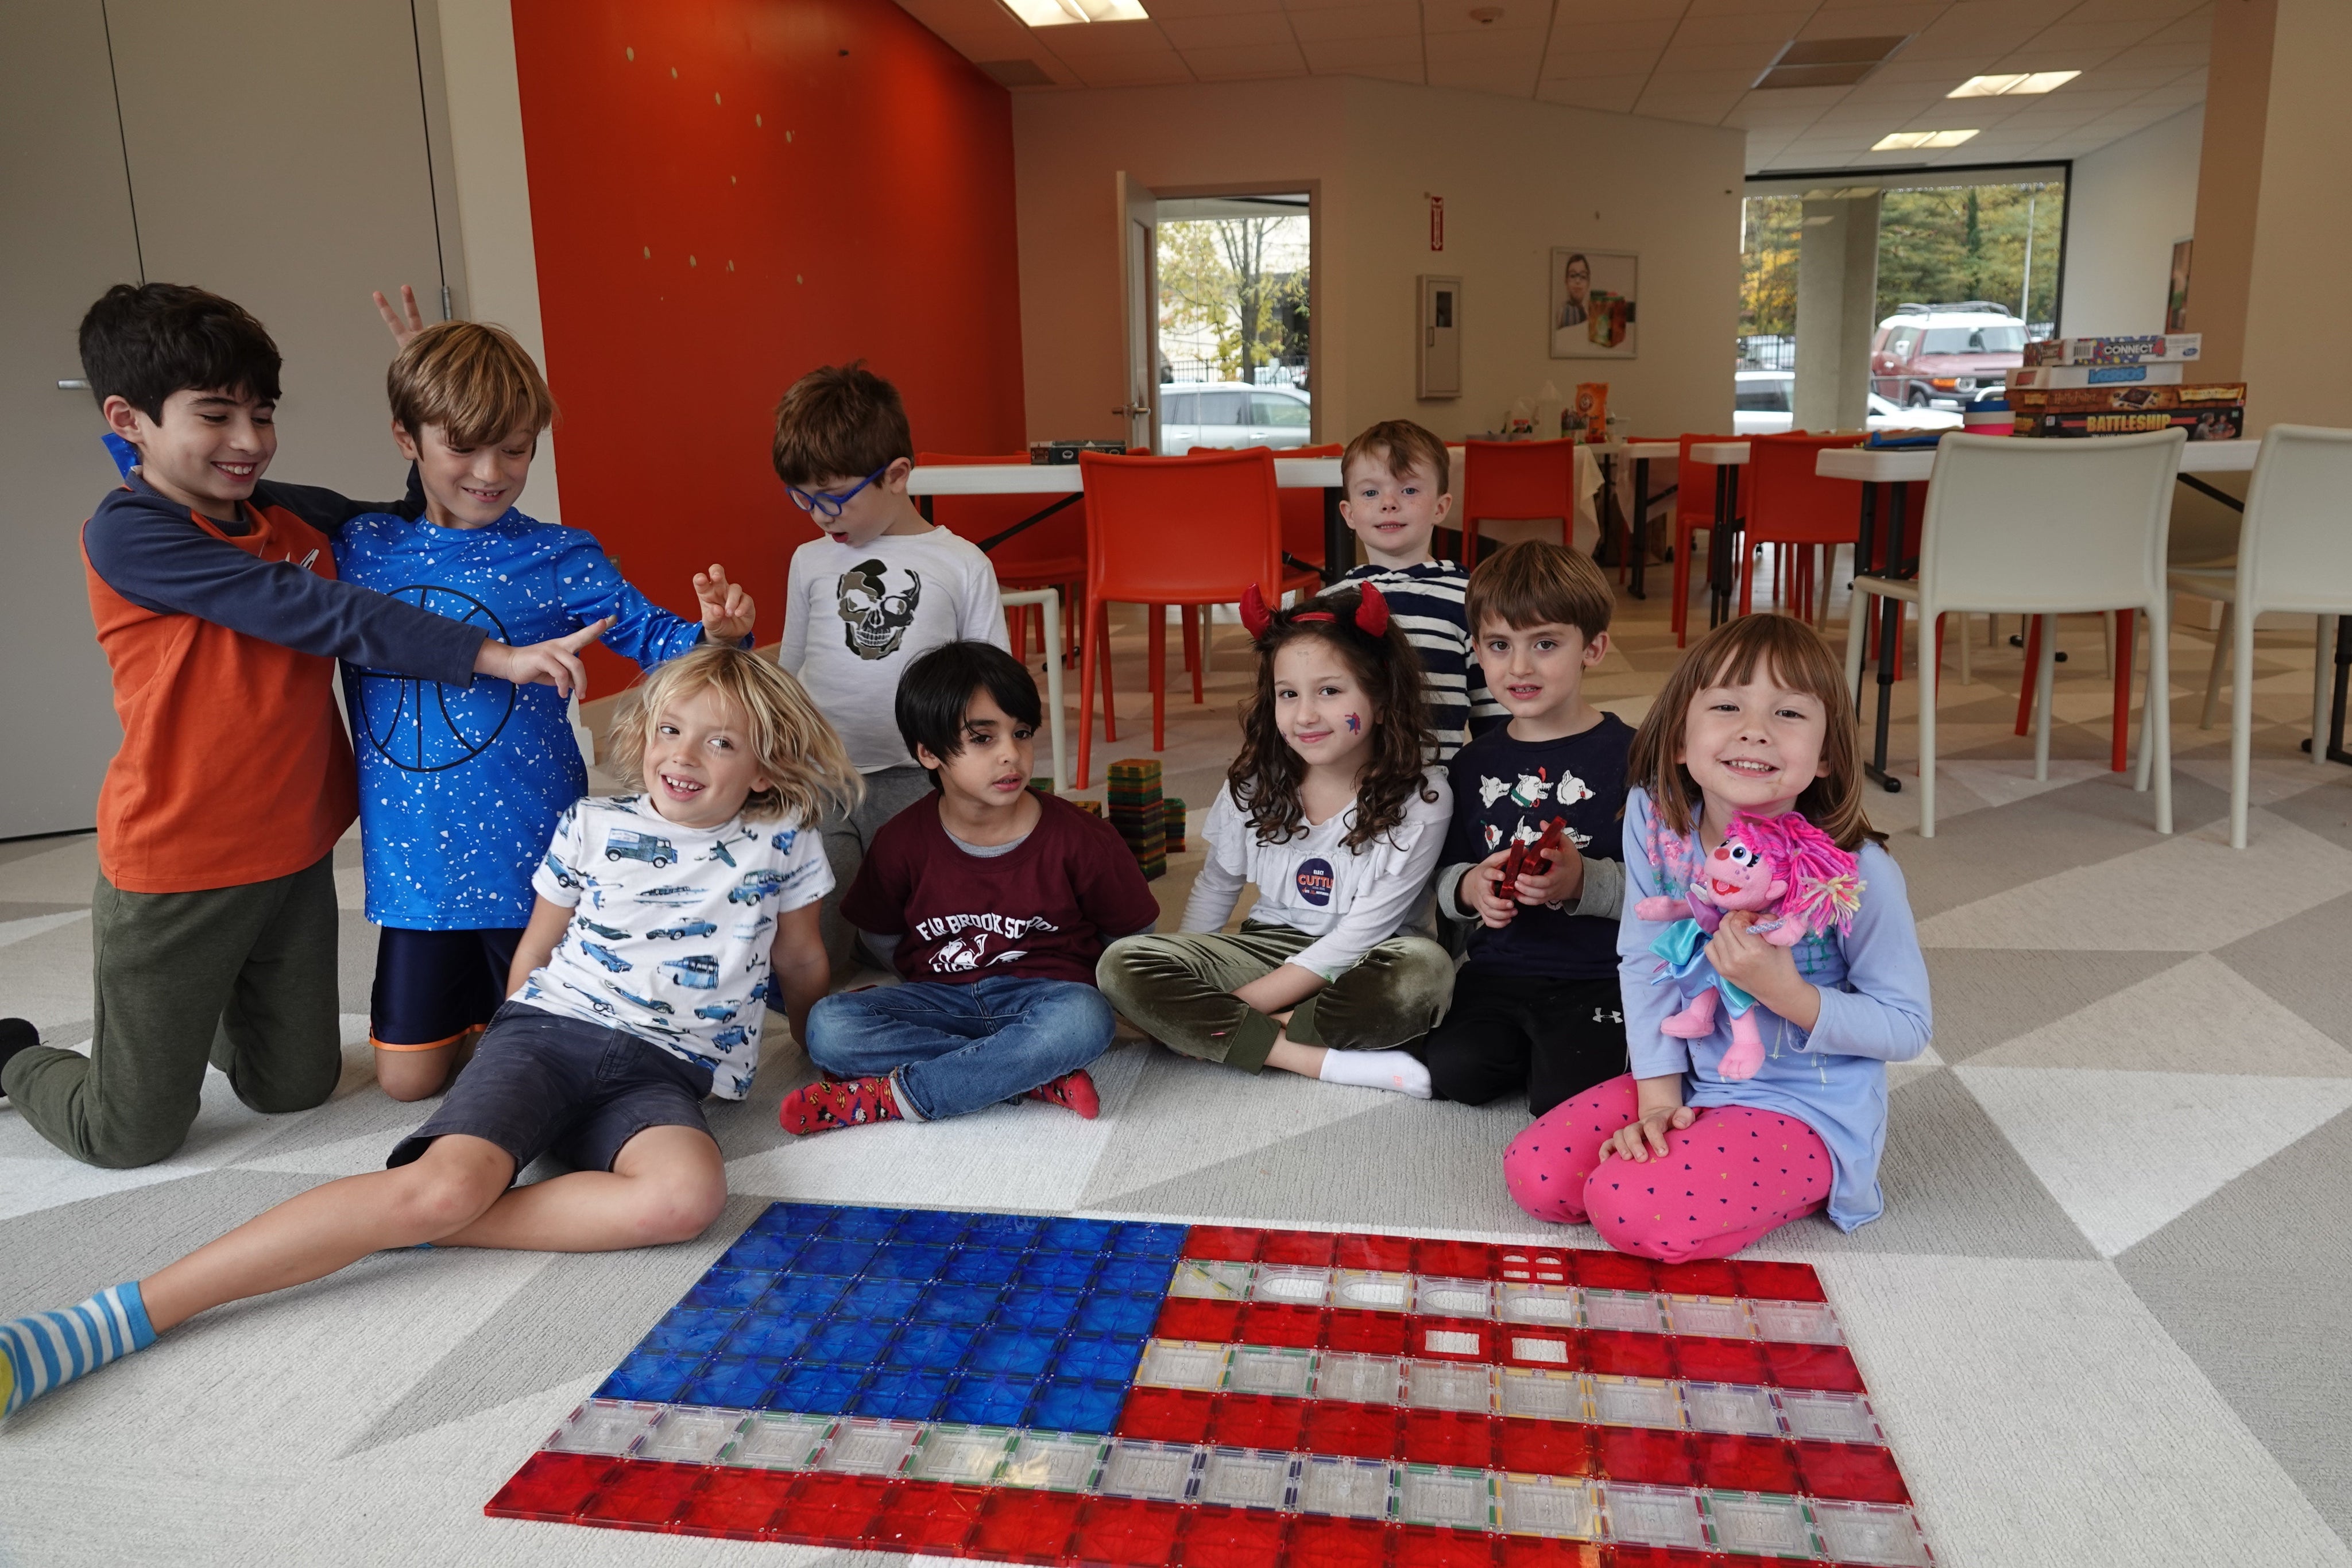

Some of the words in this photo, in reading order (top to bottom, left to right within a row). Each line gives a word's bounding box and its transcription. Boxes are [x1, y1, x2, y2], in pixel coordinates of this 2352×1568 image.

[2103, 343, 2153, 355] CONNECT
[2153, 338, 2166, 357] 4
[2086, 413, 2172, 432] BATTLESHIP
[945, 913, 1003, 935] BROOK
